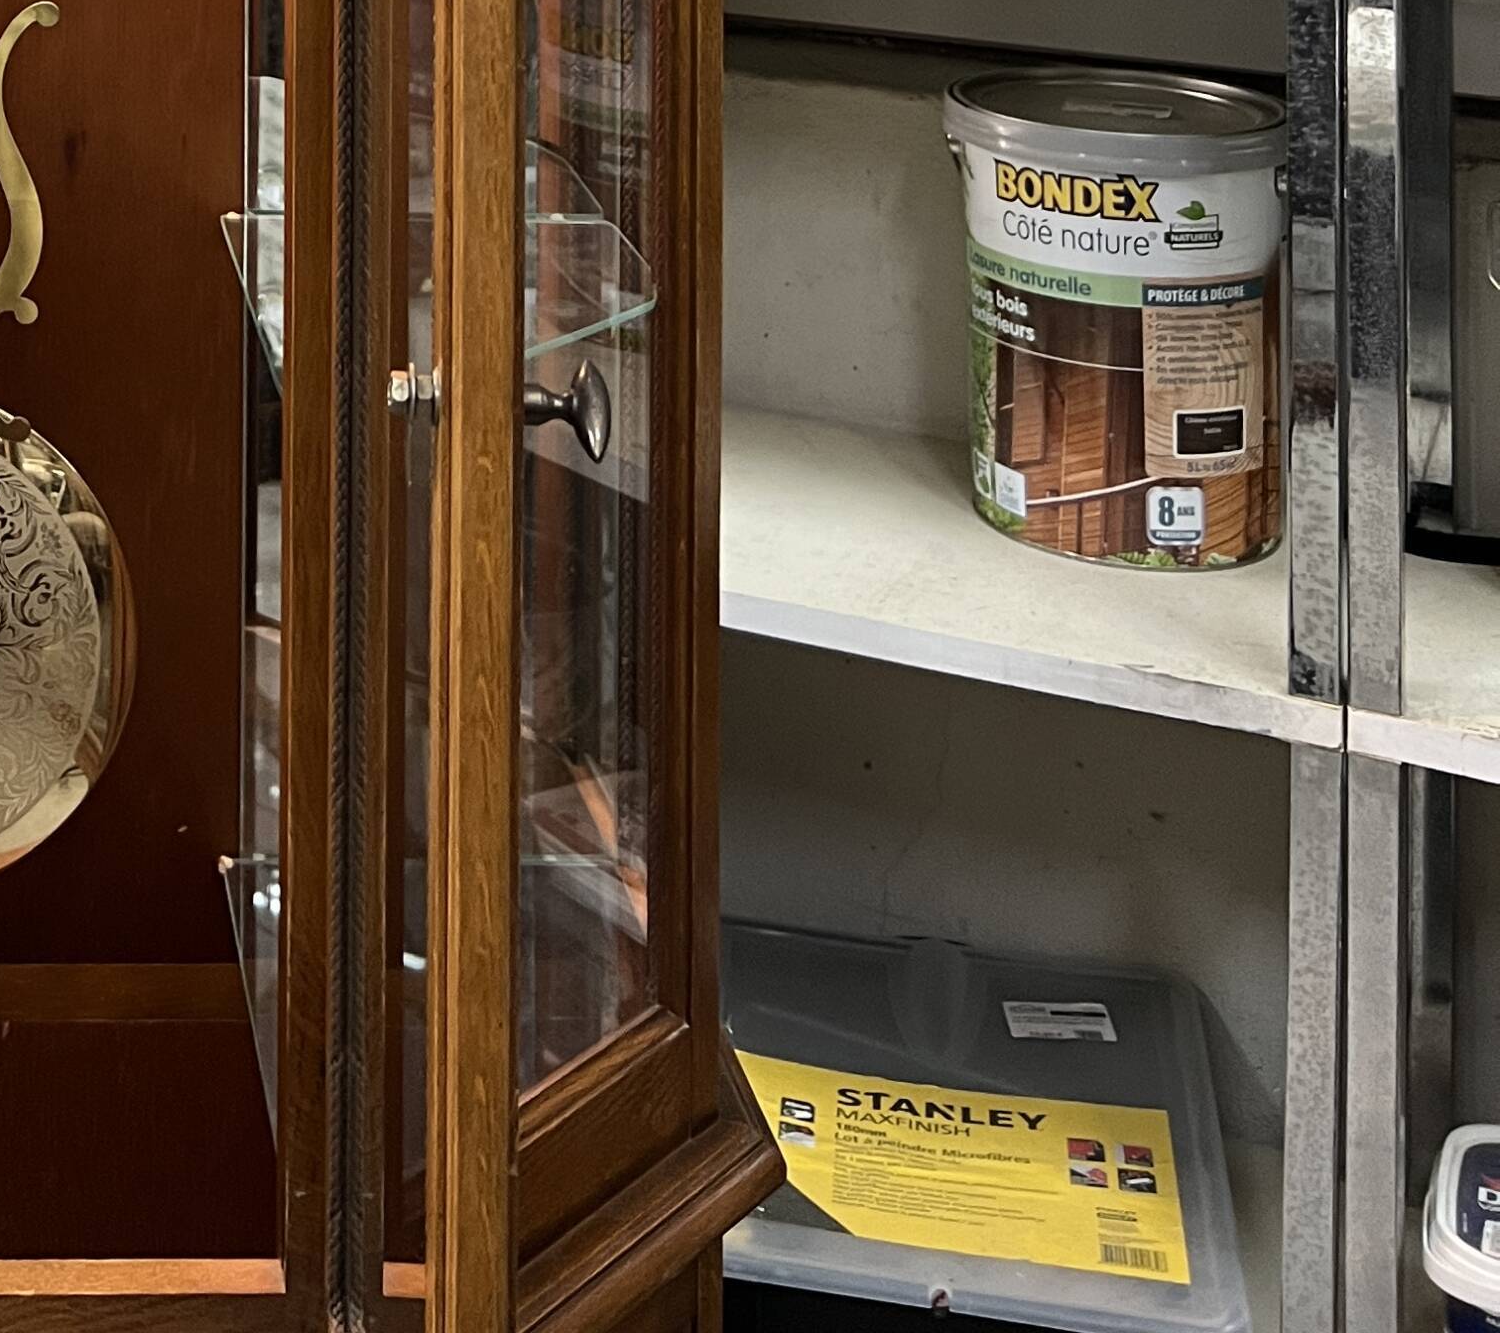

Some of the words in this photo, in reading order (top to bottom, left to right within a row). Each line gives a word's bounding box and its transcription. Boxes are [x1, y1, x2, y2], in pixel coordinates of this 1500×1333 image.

[993, 158, 1162, 222] BONDEX
[1002, 209, 1052, 245] Côté
[1062, 227, 1150, 256] nature
[1010, 266, 1092, 296] naturelle
[996, 289, 1029, 317] bois
[1158, 496, 1175, 527] 8
[836, 1107, 971, 1137] MAXFINISH
[837, 1088, 1046, 1131] STANLEY
